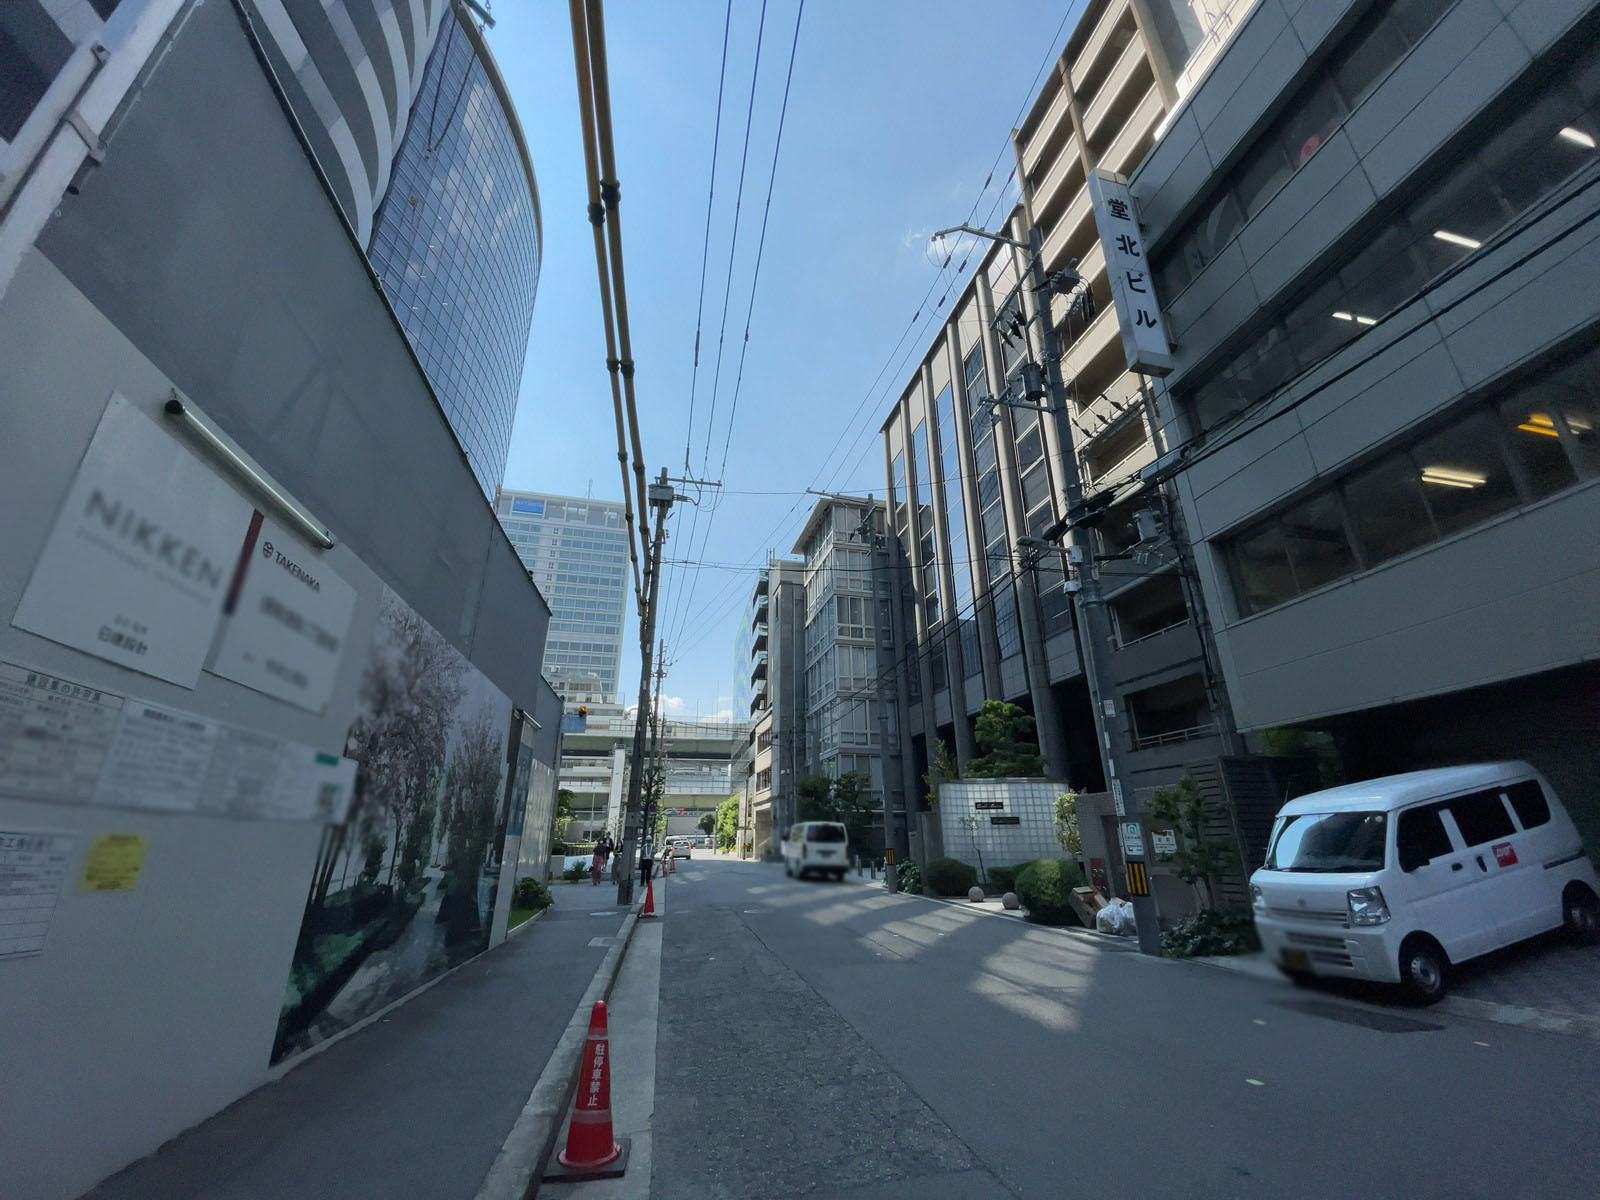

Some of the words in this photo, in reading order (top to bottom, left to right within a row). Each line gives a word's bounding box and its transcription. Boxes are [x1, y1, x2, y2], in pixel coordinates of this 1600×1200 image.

[1108, 199, 1157, 328] 堂北ビル
[84, 488, 223, 589] NIKKEN
[275, 551, 320, 592] TAKENAKA
[587, 1043, 605, 1107] 駐停車禁止
